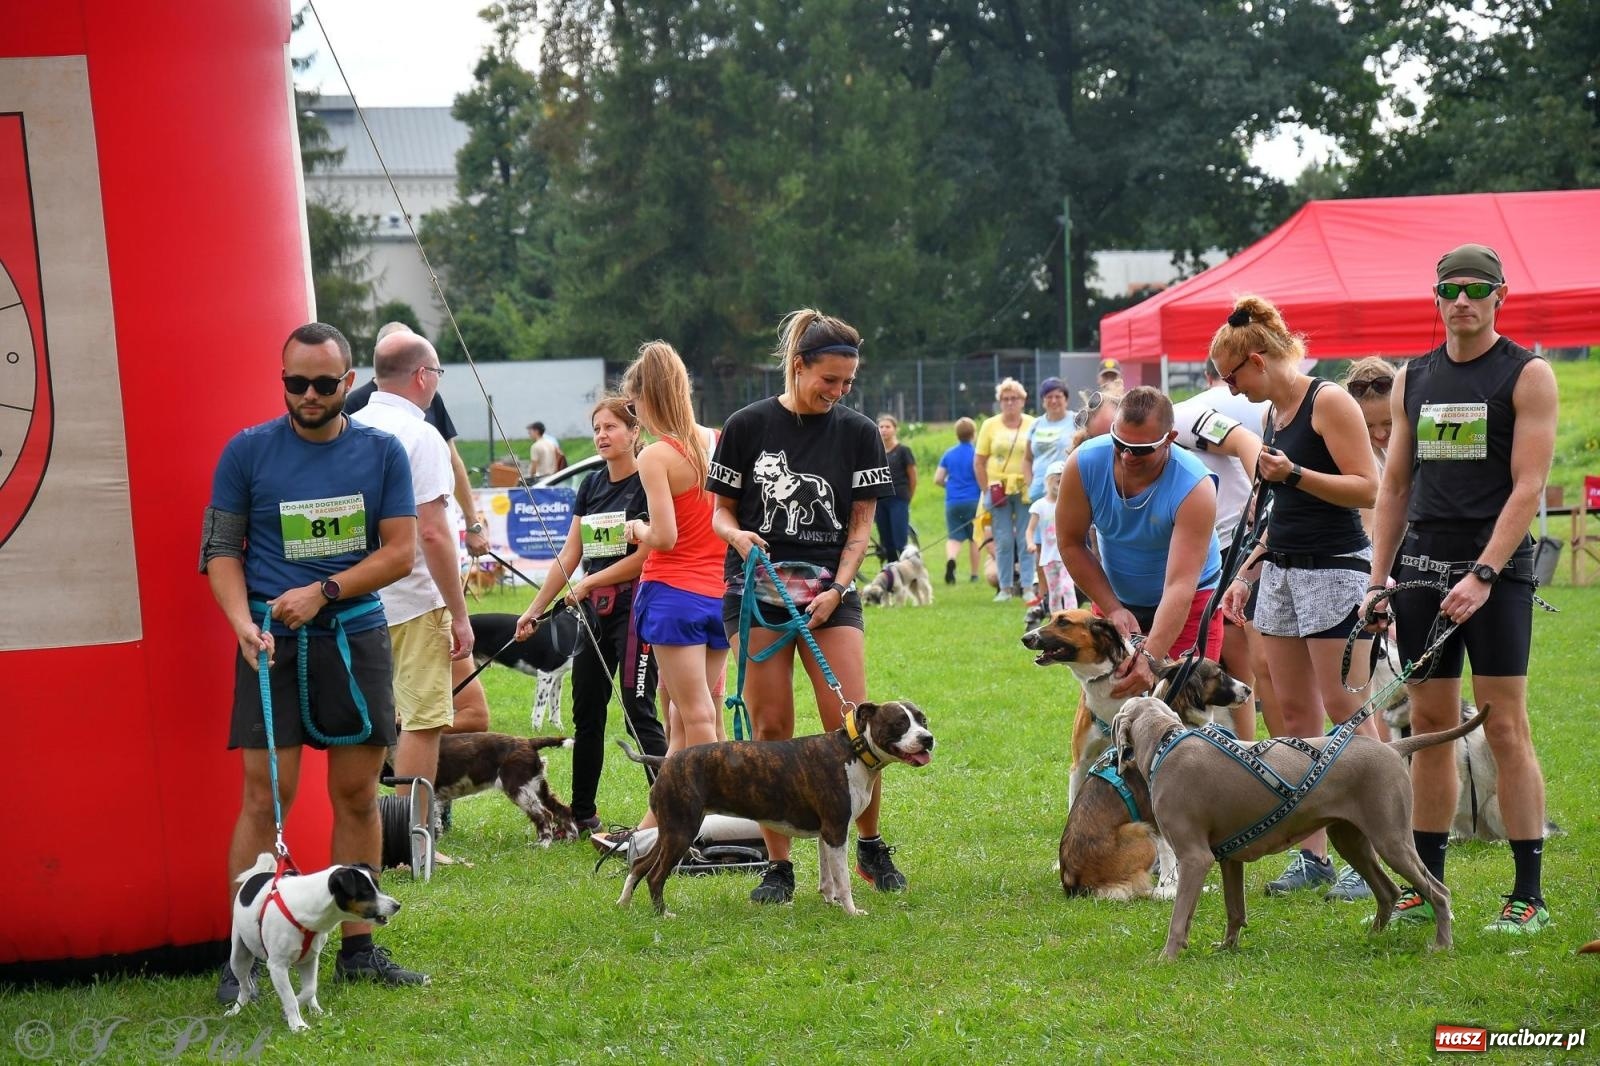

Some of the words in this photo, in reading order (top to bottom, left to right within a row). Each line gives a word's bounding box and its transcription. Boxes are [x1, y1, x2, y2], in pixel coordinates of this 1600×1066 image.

[1435, 423, 1462, 441] 77
[281, 503, 314, 512] ZOO-MAR
[315, 498, 363, 509] DOGTREKKING
[347, 503, 364, 511] 2023
[514, 502, 570, 516] Flexadin
[311, 517, 340, 538] 81
[594, 528, 610, 543] 41
[636, 654, 649, 698] PATRICK
